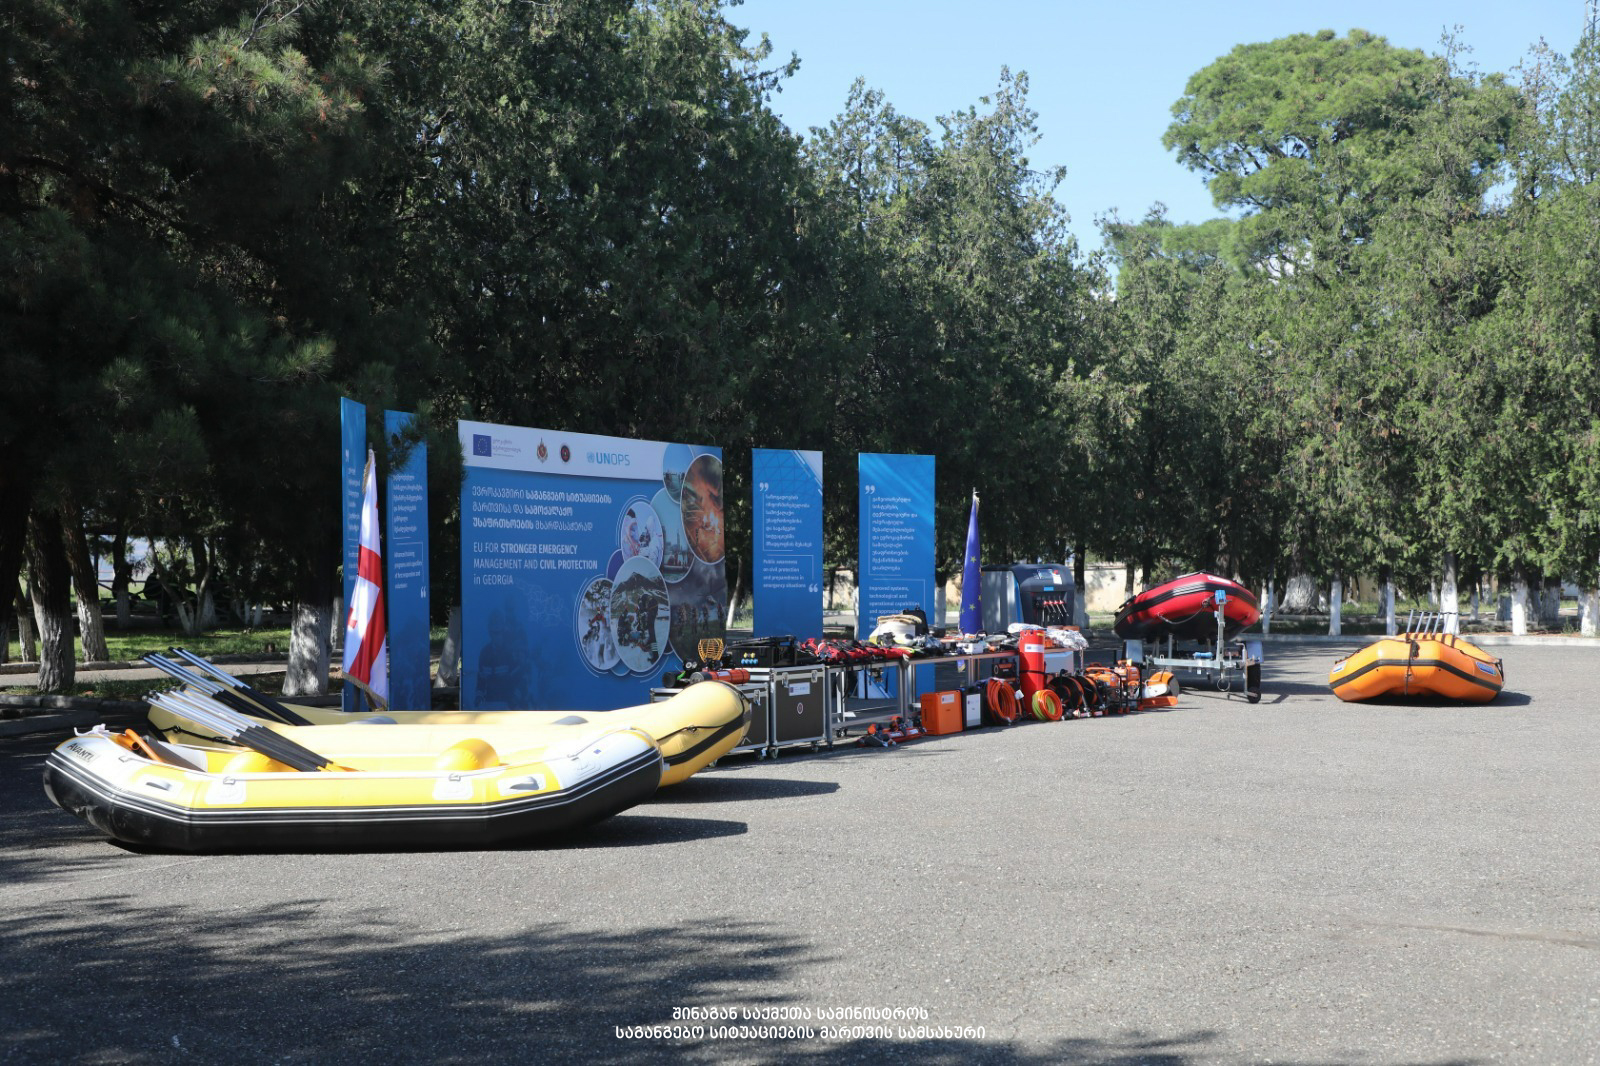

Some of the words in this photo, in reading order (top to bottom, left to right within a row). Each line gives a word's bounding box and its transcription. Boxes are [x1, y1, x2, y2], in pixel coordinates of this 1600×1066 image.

[595, 452, 630, 466] UNOPS
[513, 504, 524, 514] და
[473, 542, 483, 553] EU
[485, 542, 499, 553] FOR
[500, 543, 537, 554] STRONGER
[538, 544, 578, 555] EMERGENCY
[473, 558, 522, 569] MANAGEMENT
[523, 559, 538, 569] AND
[539, 560, 556, 570] CIVIL
[557, 560, 598, 570] PROTECTION
[473, 574, 481, 585] in
[482, 575, 514, 585] GEORGIA
[66, 742, 95, 760] AVANTI
